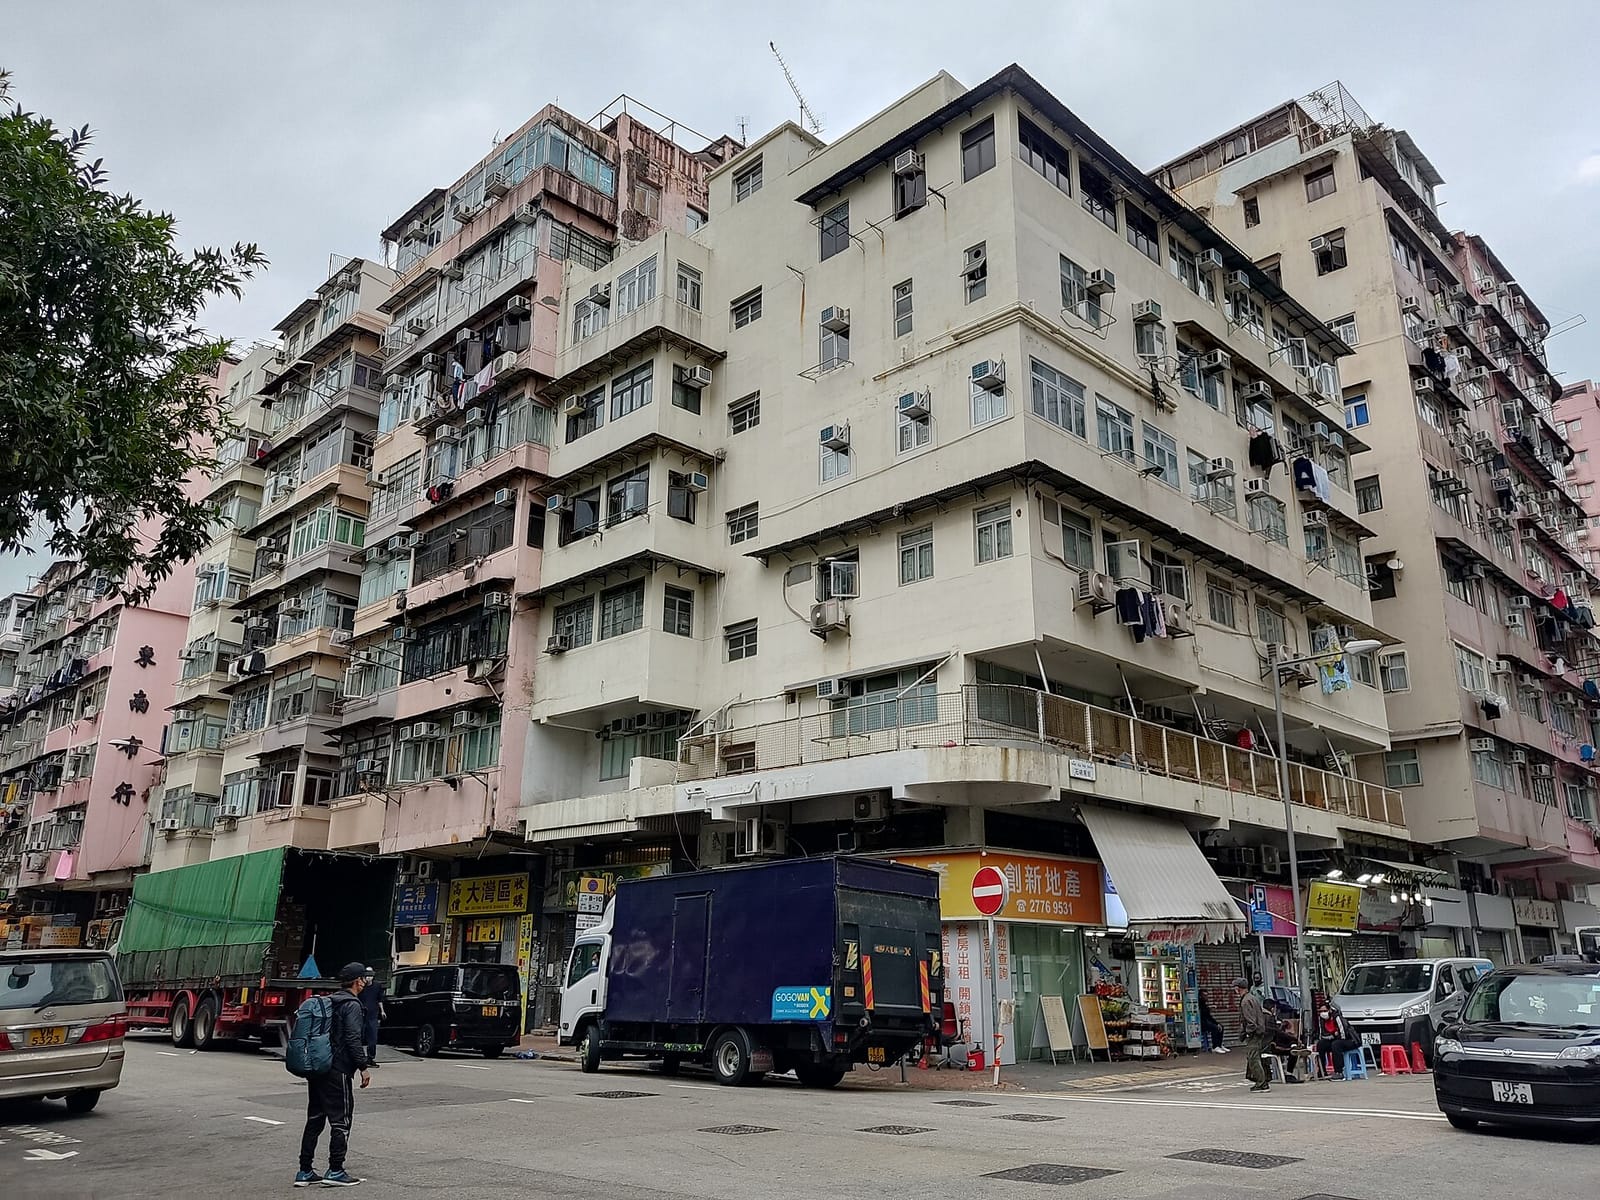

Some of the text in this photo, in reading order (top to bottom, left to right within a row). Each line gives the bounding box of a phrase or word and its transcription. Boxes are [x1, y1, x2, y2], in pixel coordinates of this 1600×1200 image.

[1003, 862, 1081, 898] 創新地產
[466, 880, 512, 904] 大灣區
[513, 876, 525, 909] 收購
[1256, 888, 1265, 909] P
[1029, 899, 1073, 915] 2776 9531
[957, 924, 970, 980] 套房出租
[775, 992, 810, 1002] GOGOVAN
[40, 1028, 54, 1037] VM
[31, 1036, 61, 1046] 5323
[1503, 1081, 1520, 1093] UF
[1498, 1091, 1528, 1104] 1928
